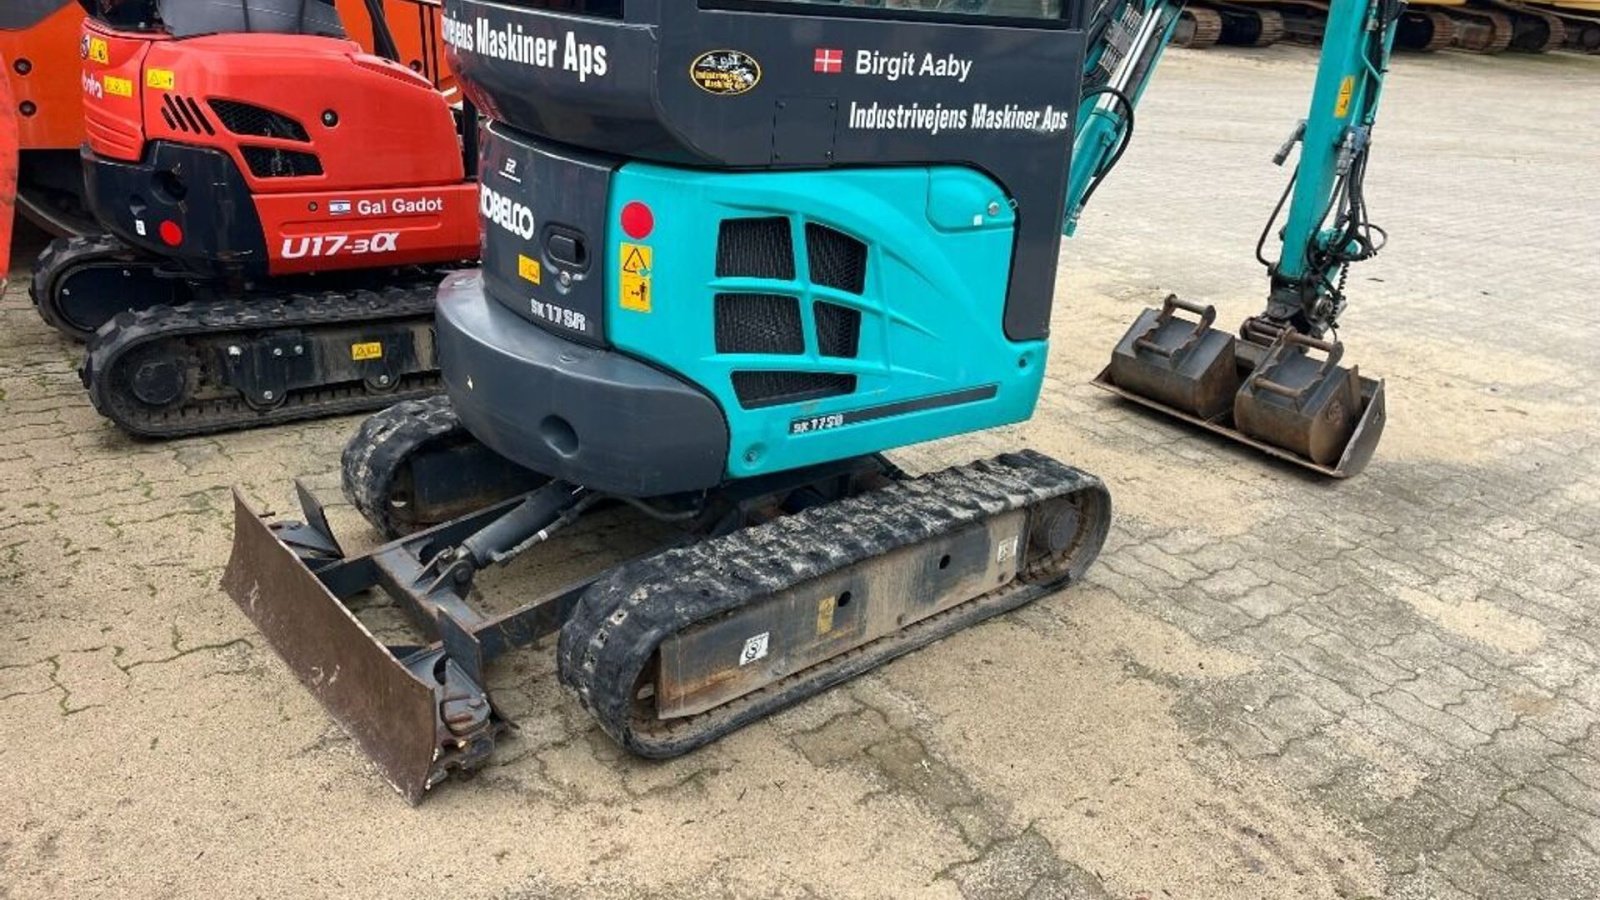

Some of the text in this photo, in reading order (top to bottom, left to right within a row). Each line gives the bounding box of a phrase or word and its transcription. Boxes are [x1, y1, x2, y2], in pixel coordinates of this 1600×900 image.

[476, 17, 557, 68] Maskiner
[563, 31, 607, 82] Aps
[855, 50, 972, 82] Birgit Aaby
[849, 101, 1069, 135] Industrivejens Maskiner Aps
[357, 197, 443, 214] Gal Gadot
